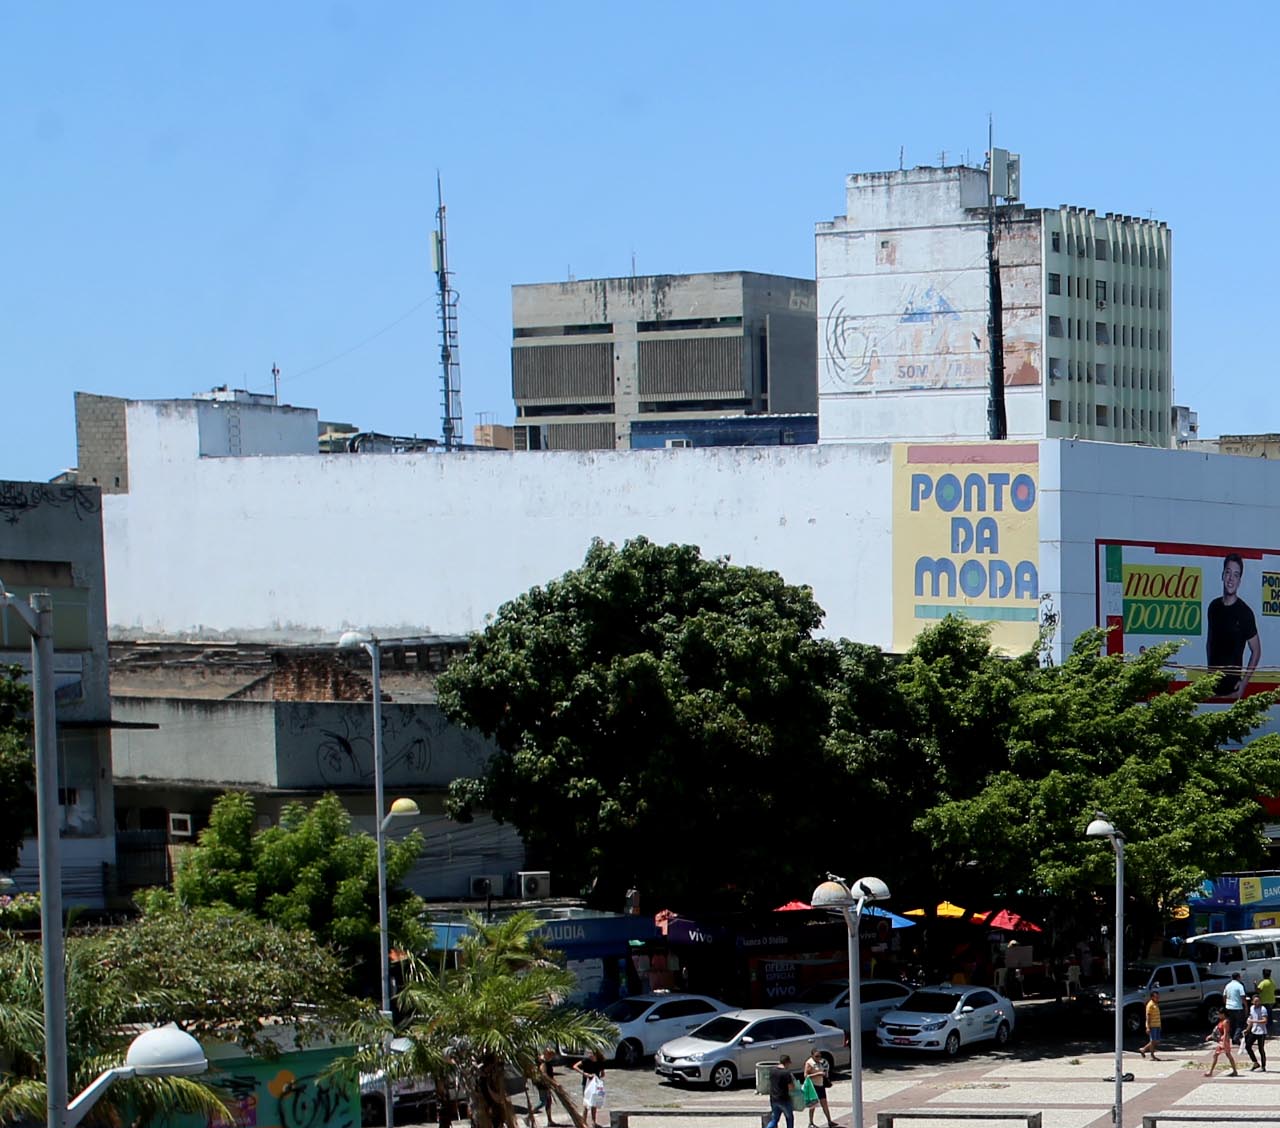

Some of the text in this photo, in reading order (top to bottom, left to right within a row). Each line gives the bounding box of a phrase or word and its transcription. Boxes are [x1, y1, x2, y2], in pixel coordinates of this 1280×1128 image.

[910, 472, 1036, 513] PONTO
[951, 516, 999, 554] DA
[914, 556, 1039, 600] MODA
[1124, 566, 1200, 599] moda
[1125, 601, 1201, 633] ponto
[688, 928, 713, 944] vivo
